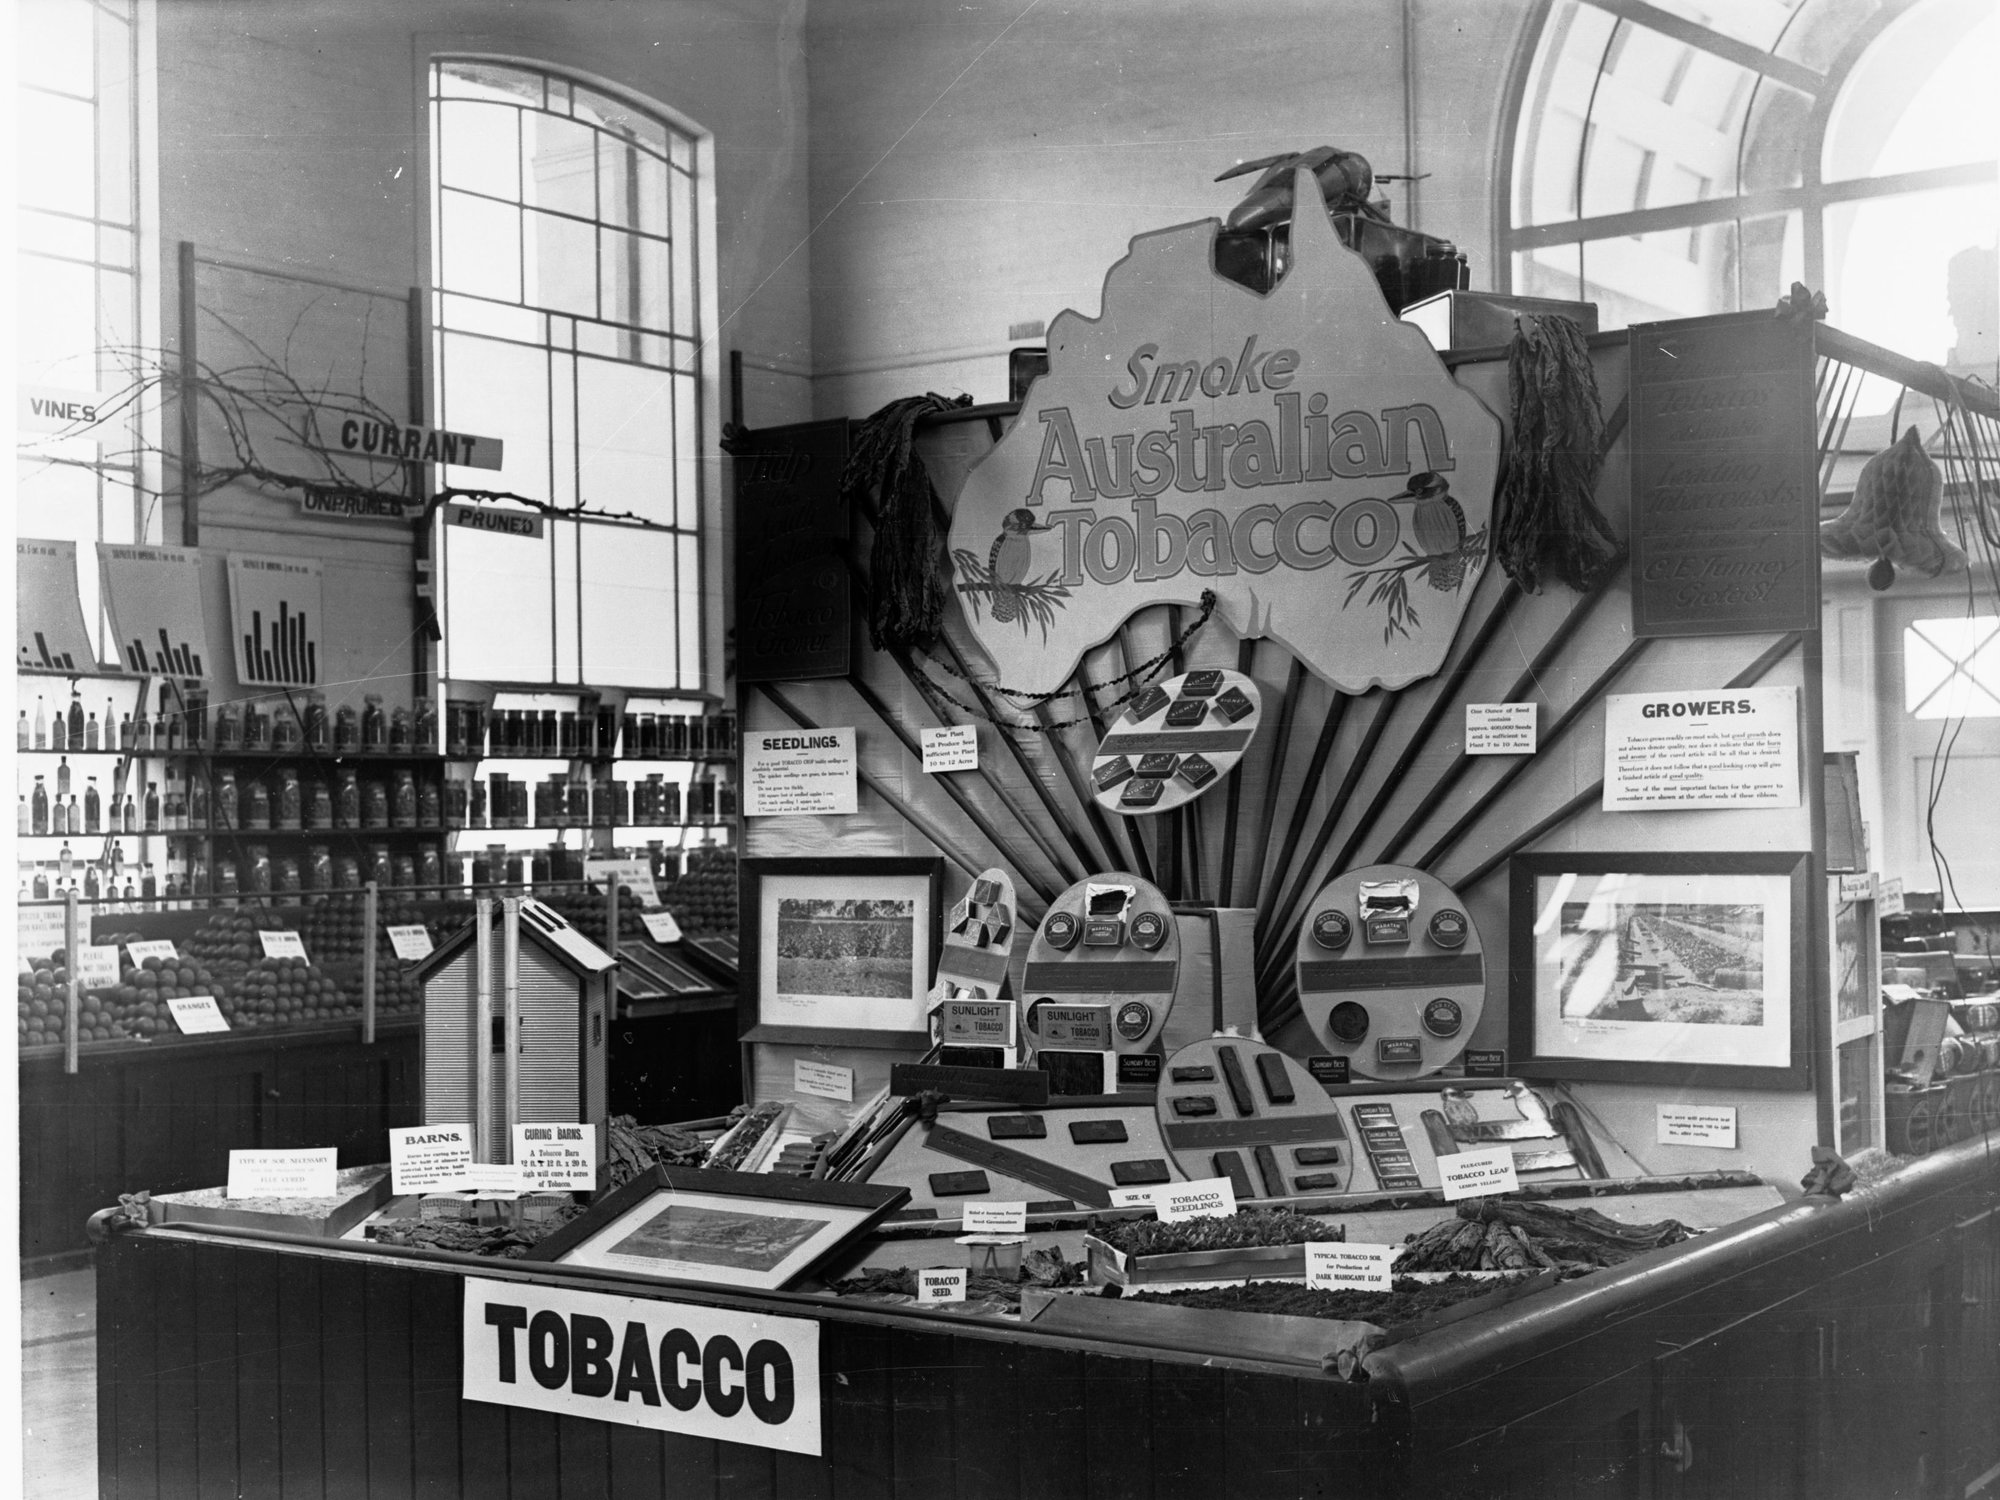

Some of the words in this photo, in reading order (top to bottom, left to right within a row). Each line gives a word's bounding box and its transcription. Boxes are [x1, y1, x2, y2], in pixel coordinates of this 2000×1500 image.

[1108, 334, 1299, 408] Smoke
[30, 397, 96, 422] VINES
[341, 419, 476, 466] CURRANT
[1025, 392, 1456, 507] Australian
[458, 509, 534, 535] PRUNED
[1047, 497, 1400, 586] Tobacco
[1170, 701, 1199, 717] SIGNET
[1641, 699, 1756, 719] GROWERS.
[1747, 731, 1766, 739] growth
[762, 735, 841, 751] SEEDLINGS.
[925, 750, 952, 758] sufficient
[961, 747, 976, 755] Plant
[1141, 754, 1171, 770] SIGNET
[1669, 772, 1683, 781] good
[1126, 781, 1155, 797] SIGNET
[82, 951, 104, 960] PLEASE
[96, 963, 114, 972] TOUCH
[176, 1002, 212, 1011] ORANGES
[951, 1005, 1001, 1016] SUNLIGHT
[1047, 1010, 1096, 1022] SUNLIGHT
[974, 1021, 1004, 1033] TOBACCO
[1071, 1026, 1100, 1037] TOBACCO
[405, 1132, 462, 1146] BARNS.
[524, 1128, 552, 1140] CURING
[557, 1128, 584, 1140] BARNS.
[529, 1149, 536, 1157] A
[539, 1148, 562, 1157] Tobacco
[564, 1148, 580, 1157] Barn
[547, 1159, 554, 1168] 12
[555, 1159, 564, 1168] ft.
[571, 1159, 580, 1168] 20
[537, 1169, 549, 1177] will
[1446, 1170, 1486, 1182] TOBACCO
[1489, 1166, 1510, 1176] LEAF
[547, 1180, 572, 1188] Tobacco.
[1479, 1179, 1502, 1187] YELLOW
[1124, 1194, 1141, 1202] SIZE
[1170, 1192, 1220, 1205] TOBACCO
[1169, 1200, 1224, 1214] SEEDLINGS
[1313, 1252, 1338, 1260] TYPICAL
[1339, 1253, 1369, 1261] TOBACCO
[1368, 1254, 1382, 1262] SOIL
[1335, 1263, 1363, 1272] Production
[924, 1276, 960, 1286] TOBACCO
[1315, 1272, 1332, 1282] DARK
[1333, 1273, 1366, 1283] MAHOGANY
[1367, 1273, 1383, 1283] LEAF
[932, 1287, 953, 1297] SEED.
[484, 1300, 796, 1426] TOBACCO
